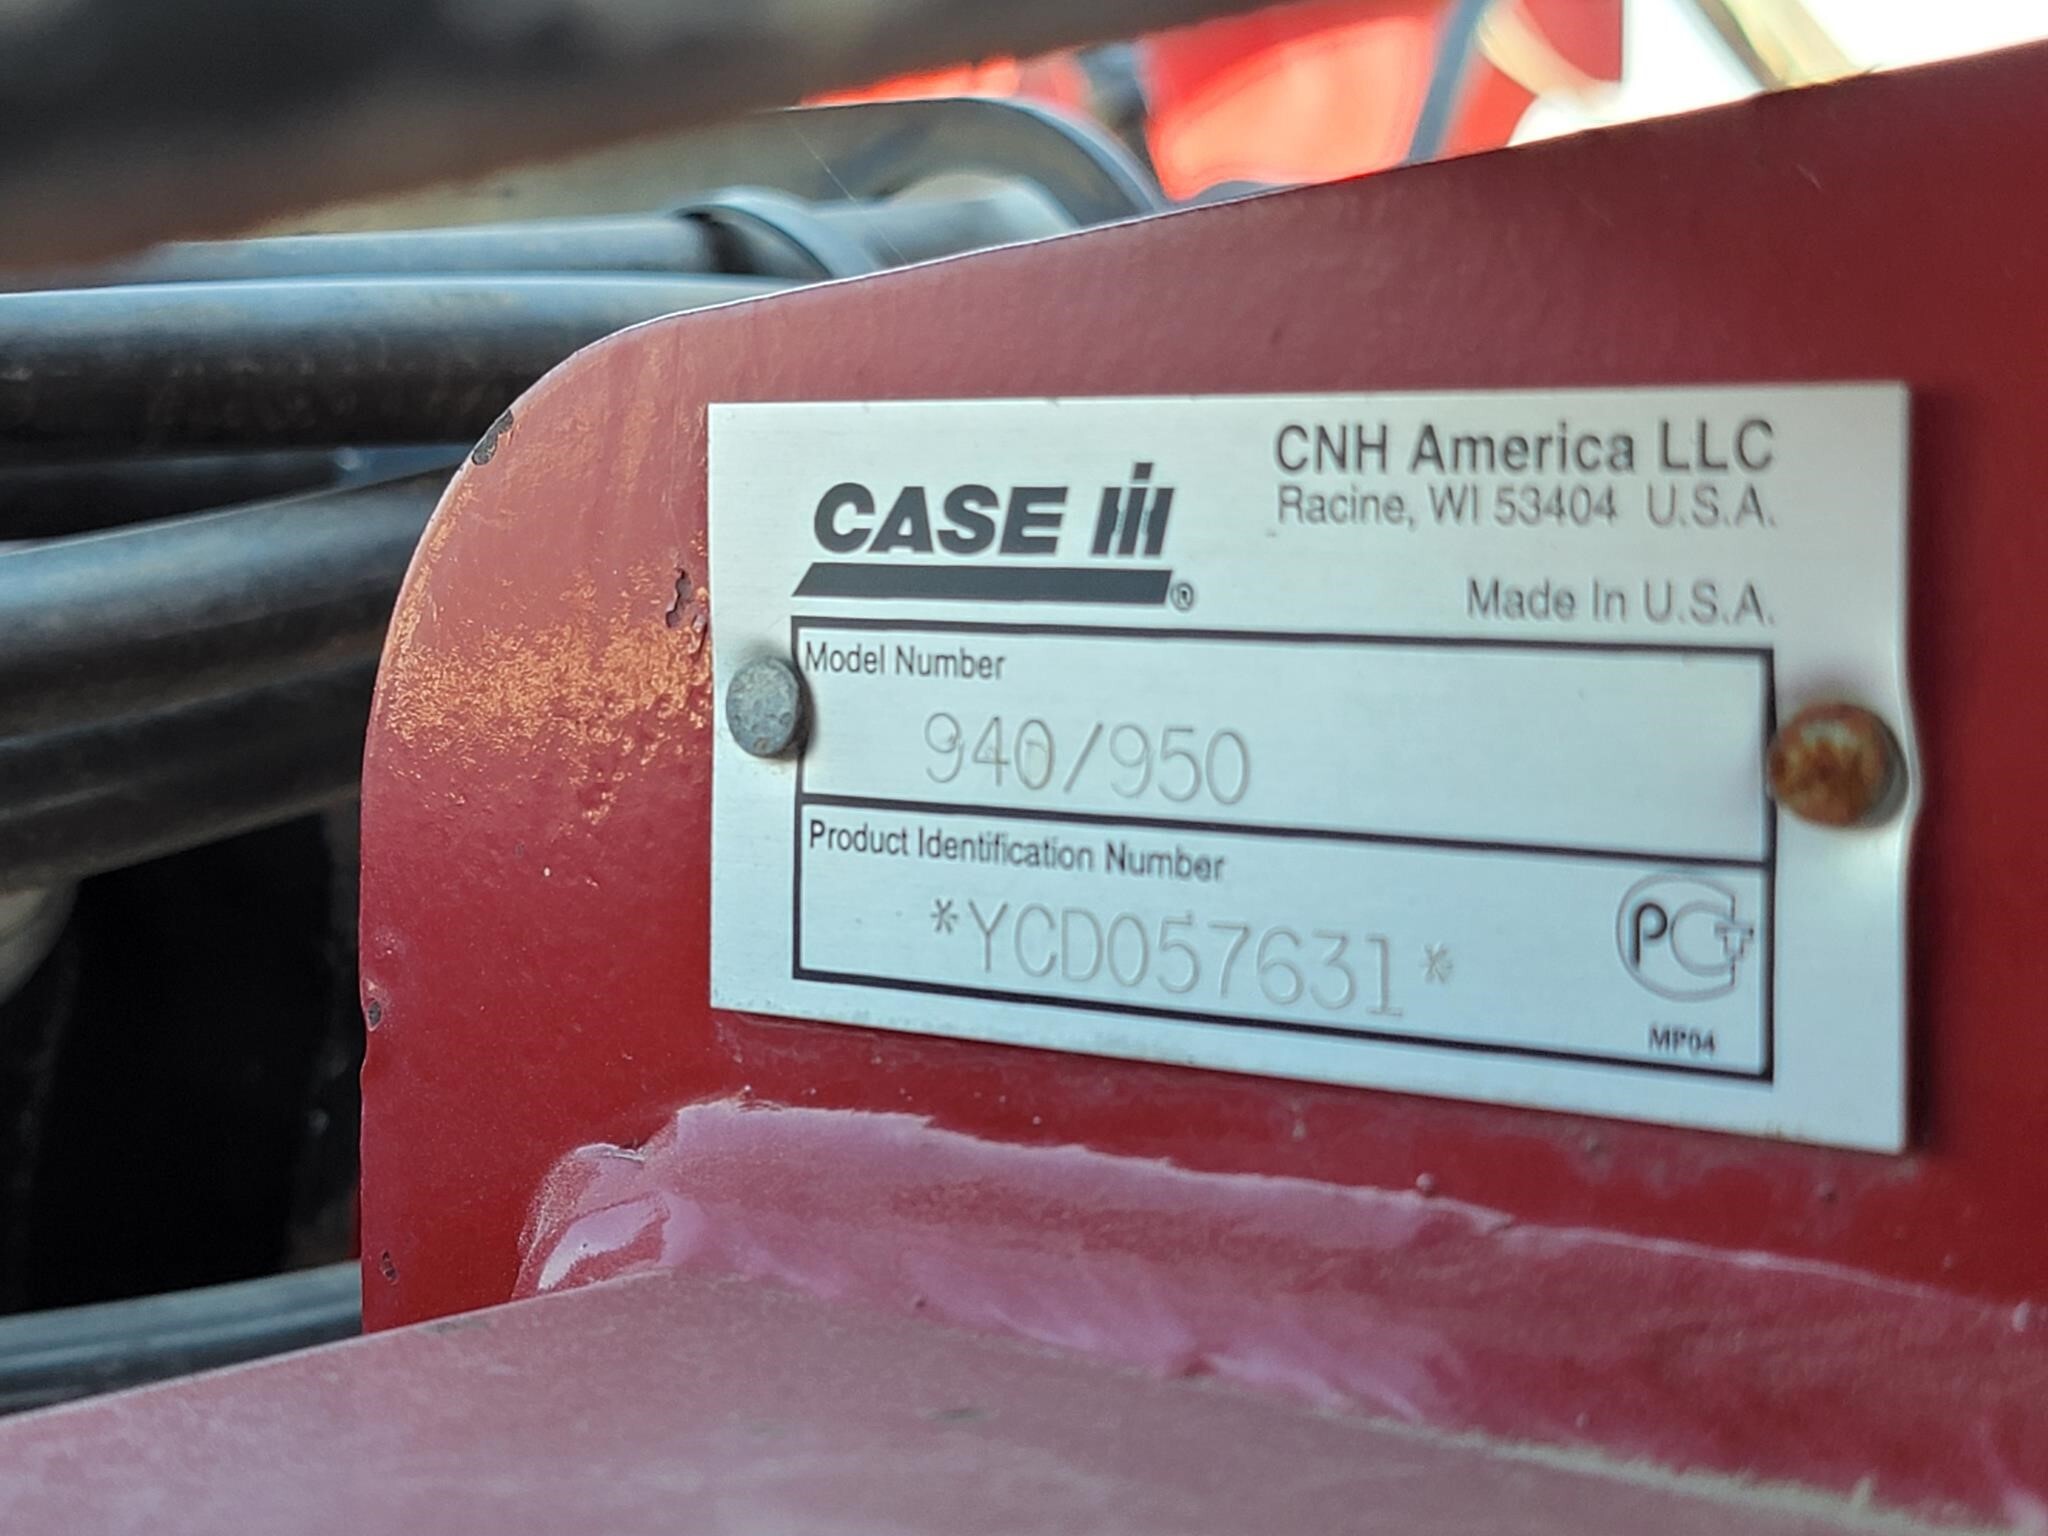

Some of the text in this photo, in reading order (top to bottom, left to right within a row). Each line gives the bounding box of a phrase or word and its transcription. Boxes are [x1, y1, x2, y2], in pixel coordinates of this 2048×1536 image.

[1275, 416, 1774, 474] CNH America LLC
[813, 482, 1069, 555] CASE
[1278, 484, 1777, 530] Racine, WI 53404 U.S.A.
[1466, 577, 1776, 625] Made In U.S.A.
[804, 643, 1005, 682] Model Number
[923, 711, 1251, 806] 940/950
[809, 819, 1226, 882] Product Identification Number
